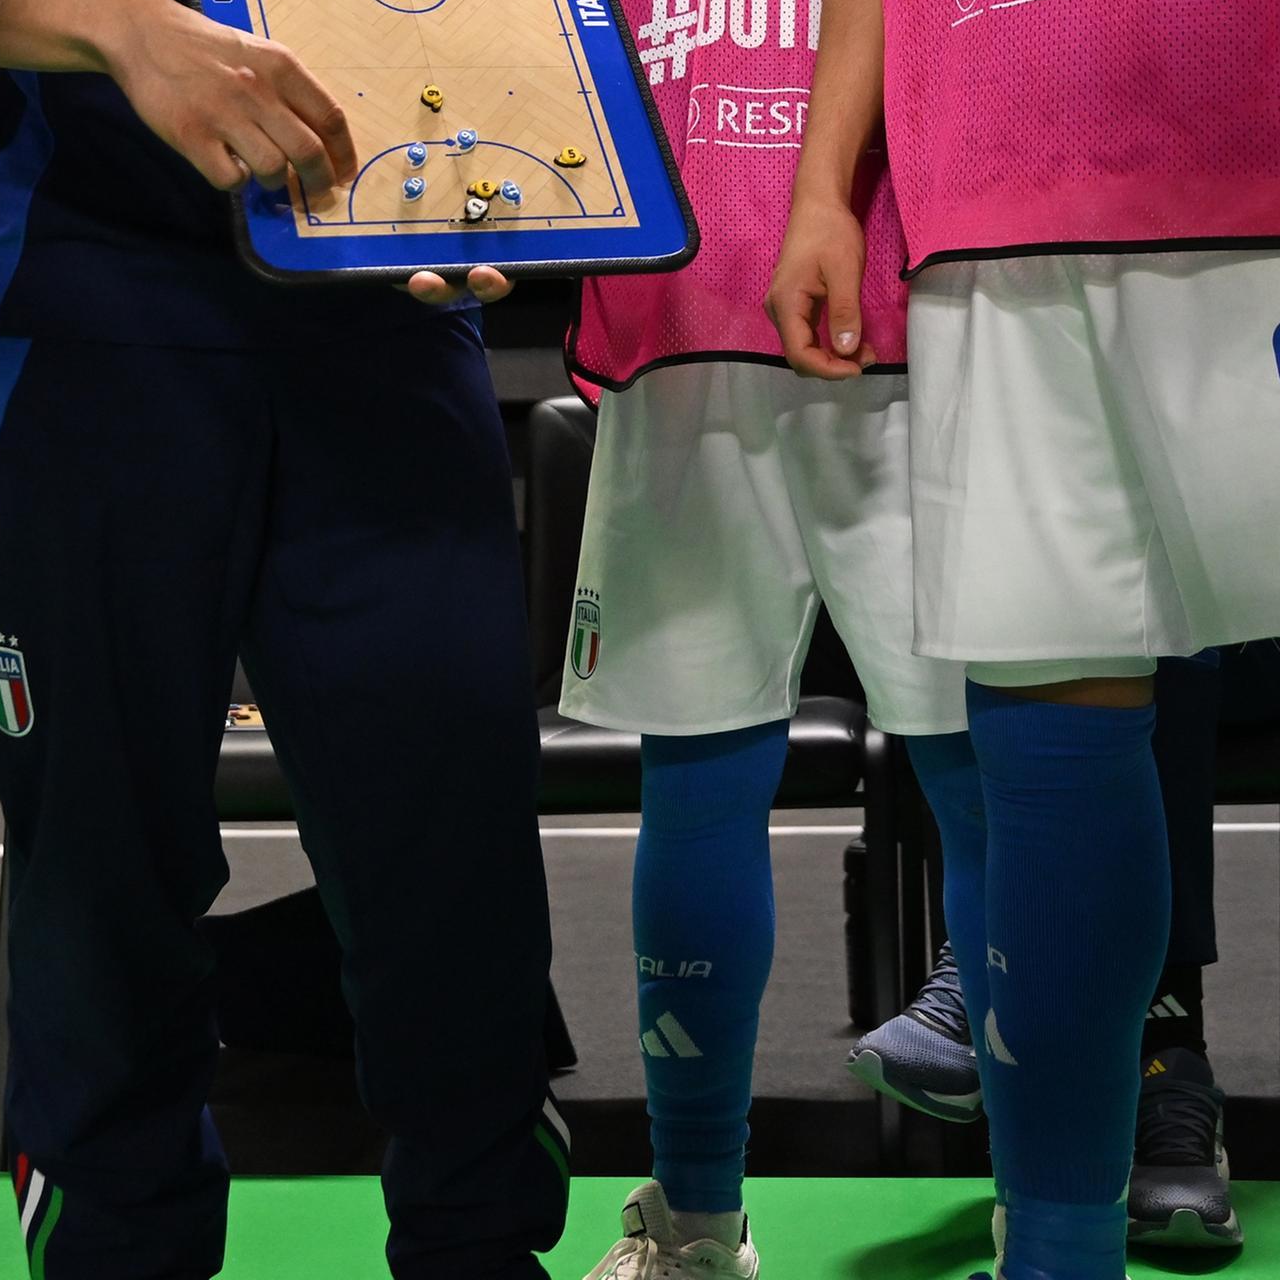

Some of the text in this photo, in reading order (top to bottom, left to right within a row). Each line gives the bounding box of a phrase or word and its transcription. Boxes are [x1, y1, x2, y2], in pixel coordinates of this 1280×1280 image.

[414, 146, 424, 157] 8
[567, 149, 576, 159] 5
[410, 177, 422, 192] 10
[482, 182, 490, 191] 3
[578, 606, 598, 625] ITALIA
